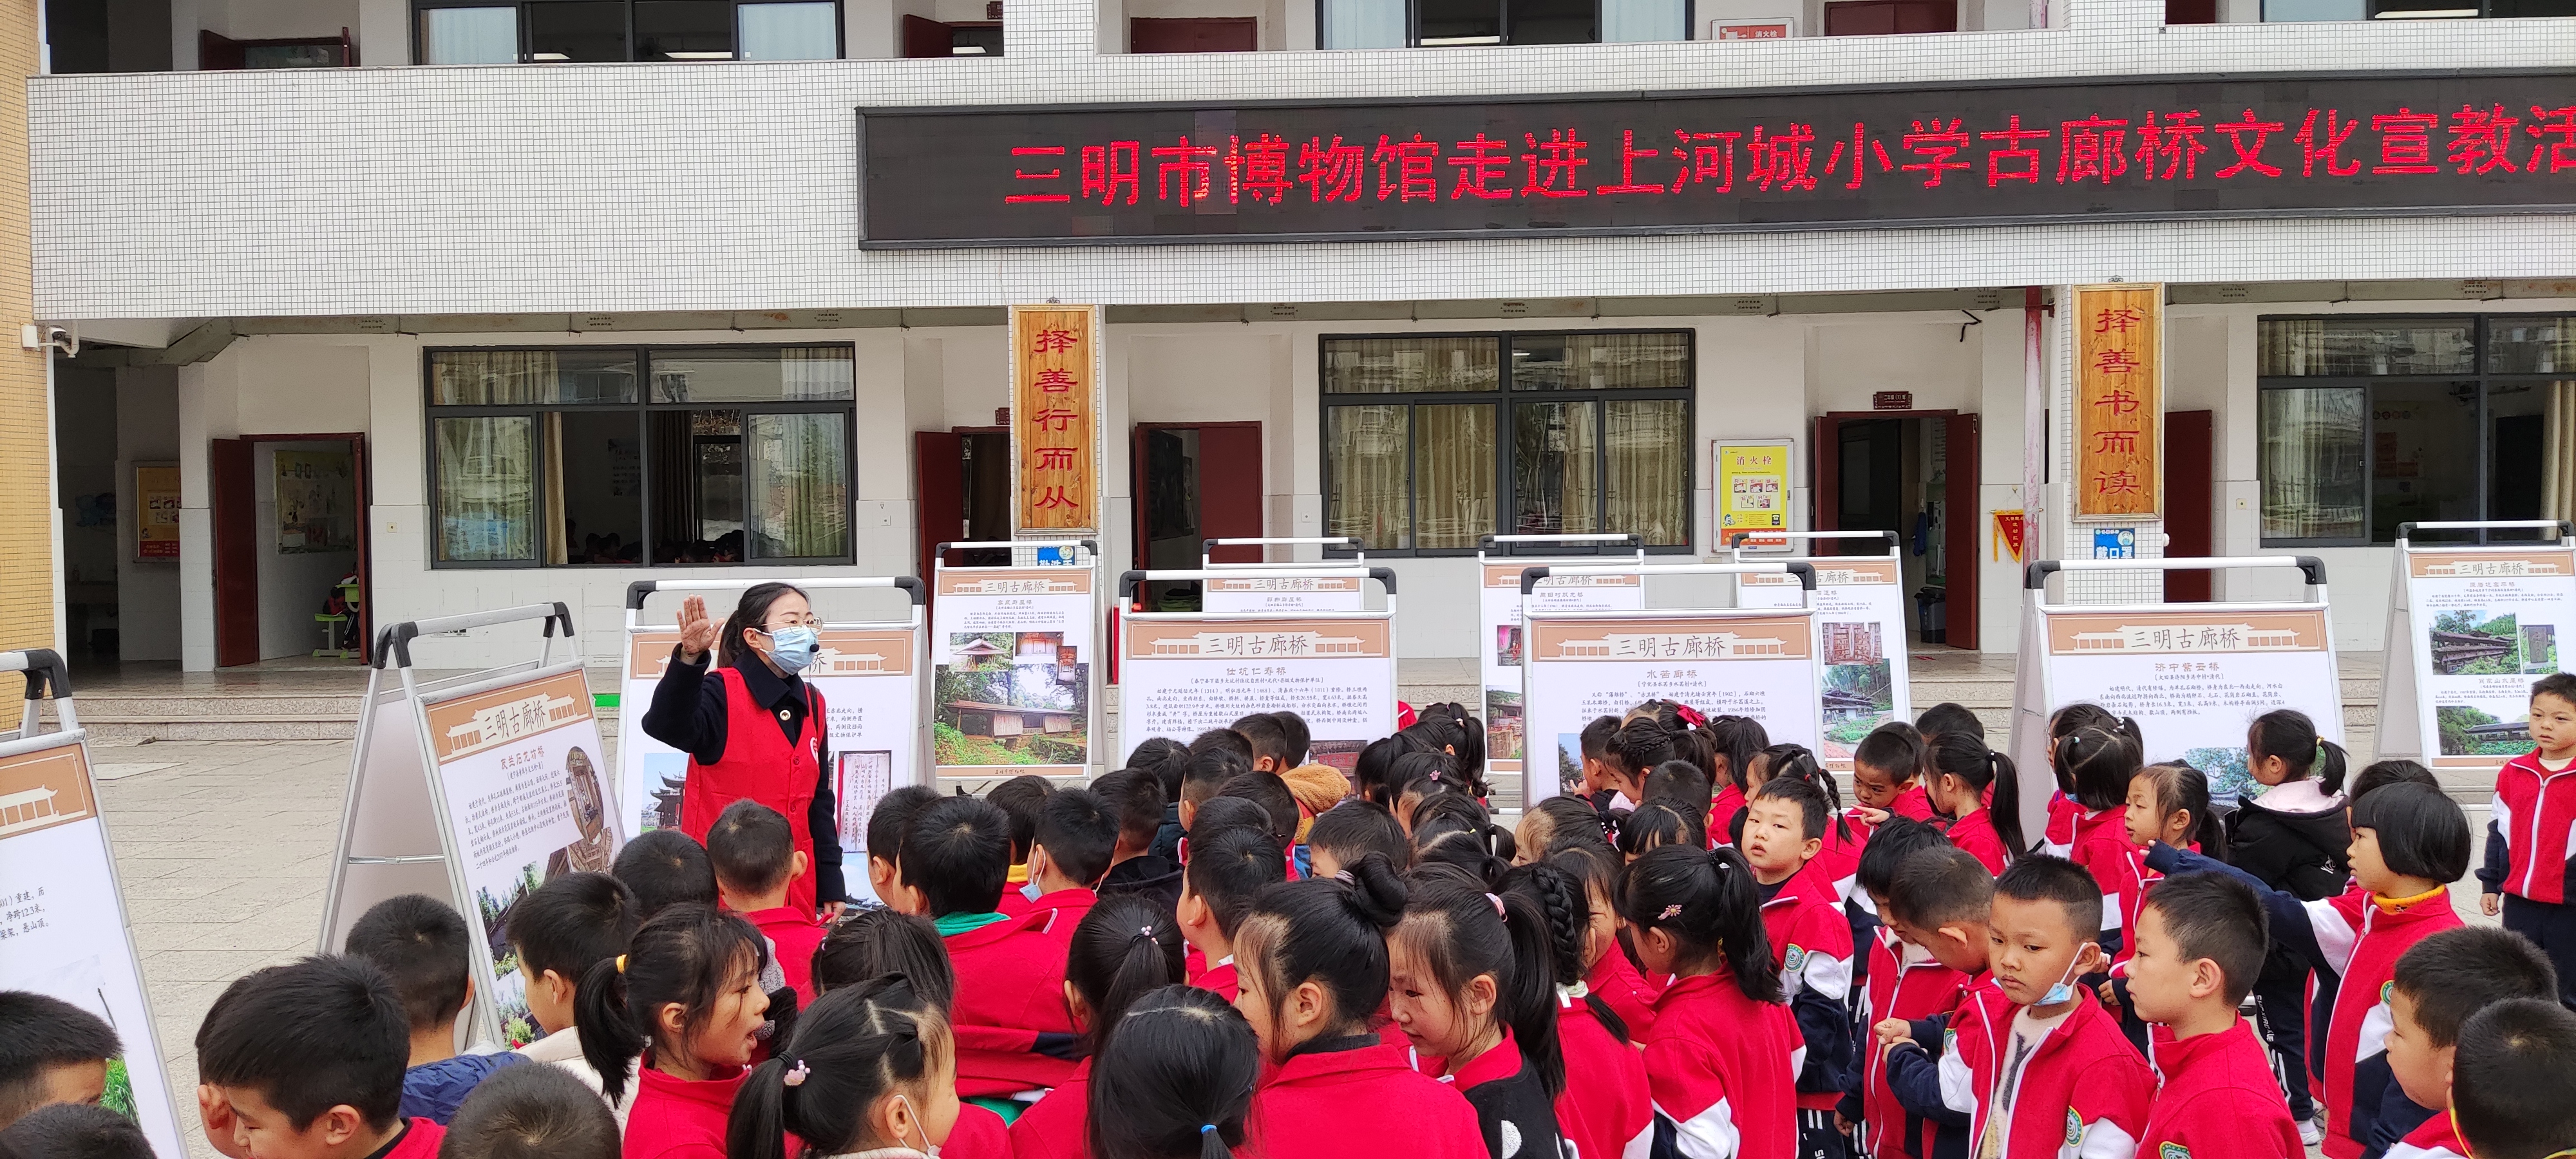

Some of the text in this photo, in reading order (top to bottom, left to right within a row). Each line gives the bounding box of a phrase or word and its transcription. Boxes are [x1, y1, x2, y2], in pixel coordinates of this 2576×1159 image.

[2094, 308, 2141, 496] 择善书而读
[1034, 330, 1079, 511] 择善行而从
[1737, 455, 1772, 466] 消火栓
[2096, 546, 2133, 560] 戴口罩
[2459, 562, 2524, 576] 三明古廊桥
[1255, 578, 1314, 590] 三明古廊桥
[1788, 571, 1849, 583] 三古廊桥
[985, 580, 1045, 594] 三明古廊桥
[1206, 634, 1309, 656] 三明古廊桥
[2131, 627, 2241, 650] 三明古廊桥
[1616, 636, 1727, 658] 三明古廊桥
[1226, 667, 1287, 676] 仕坑仁寿桥
[2155, 662, 2220, 672] 济中紫云桥
[485, 700, 545, 740] 三明古廊桥
